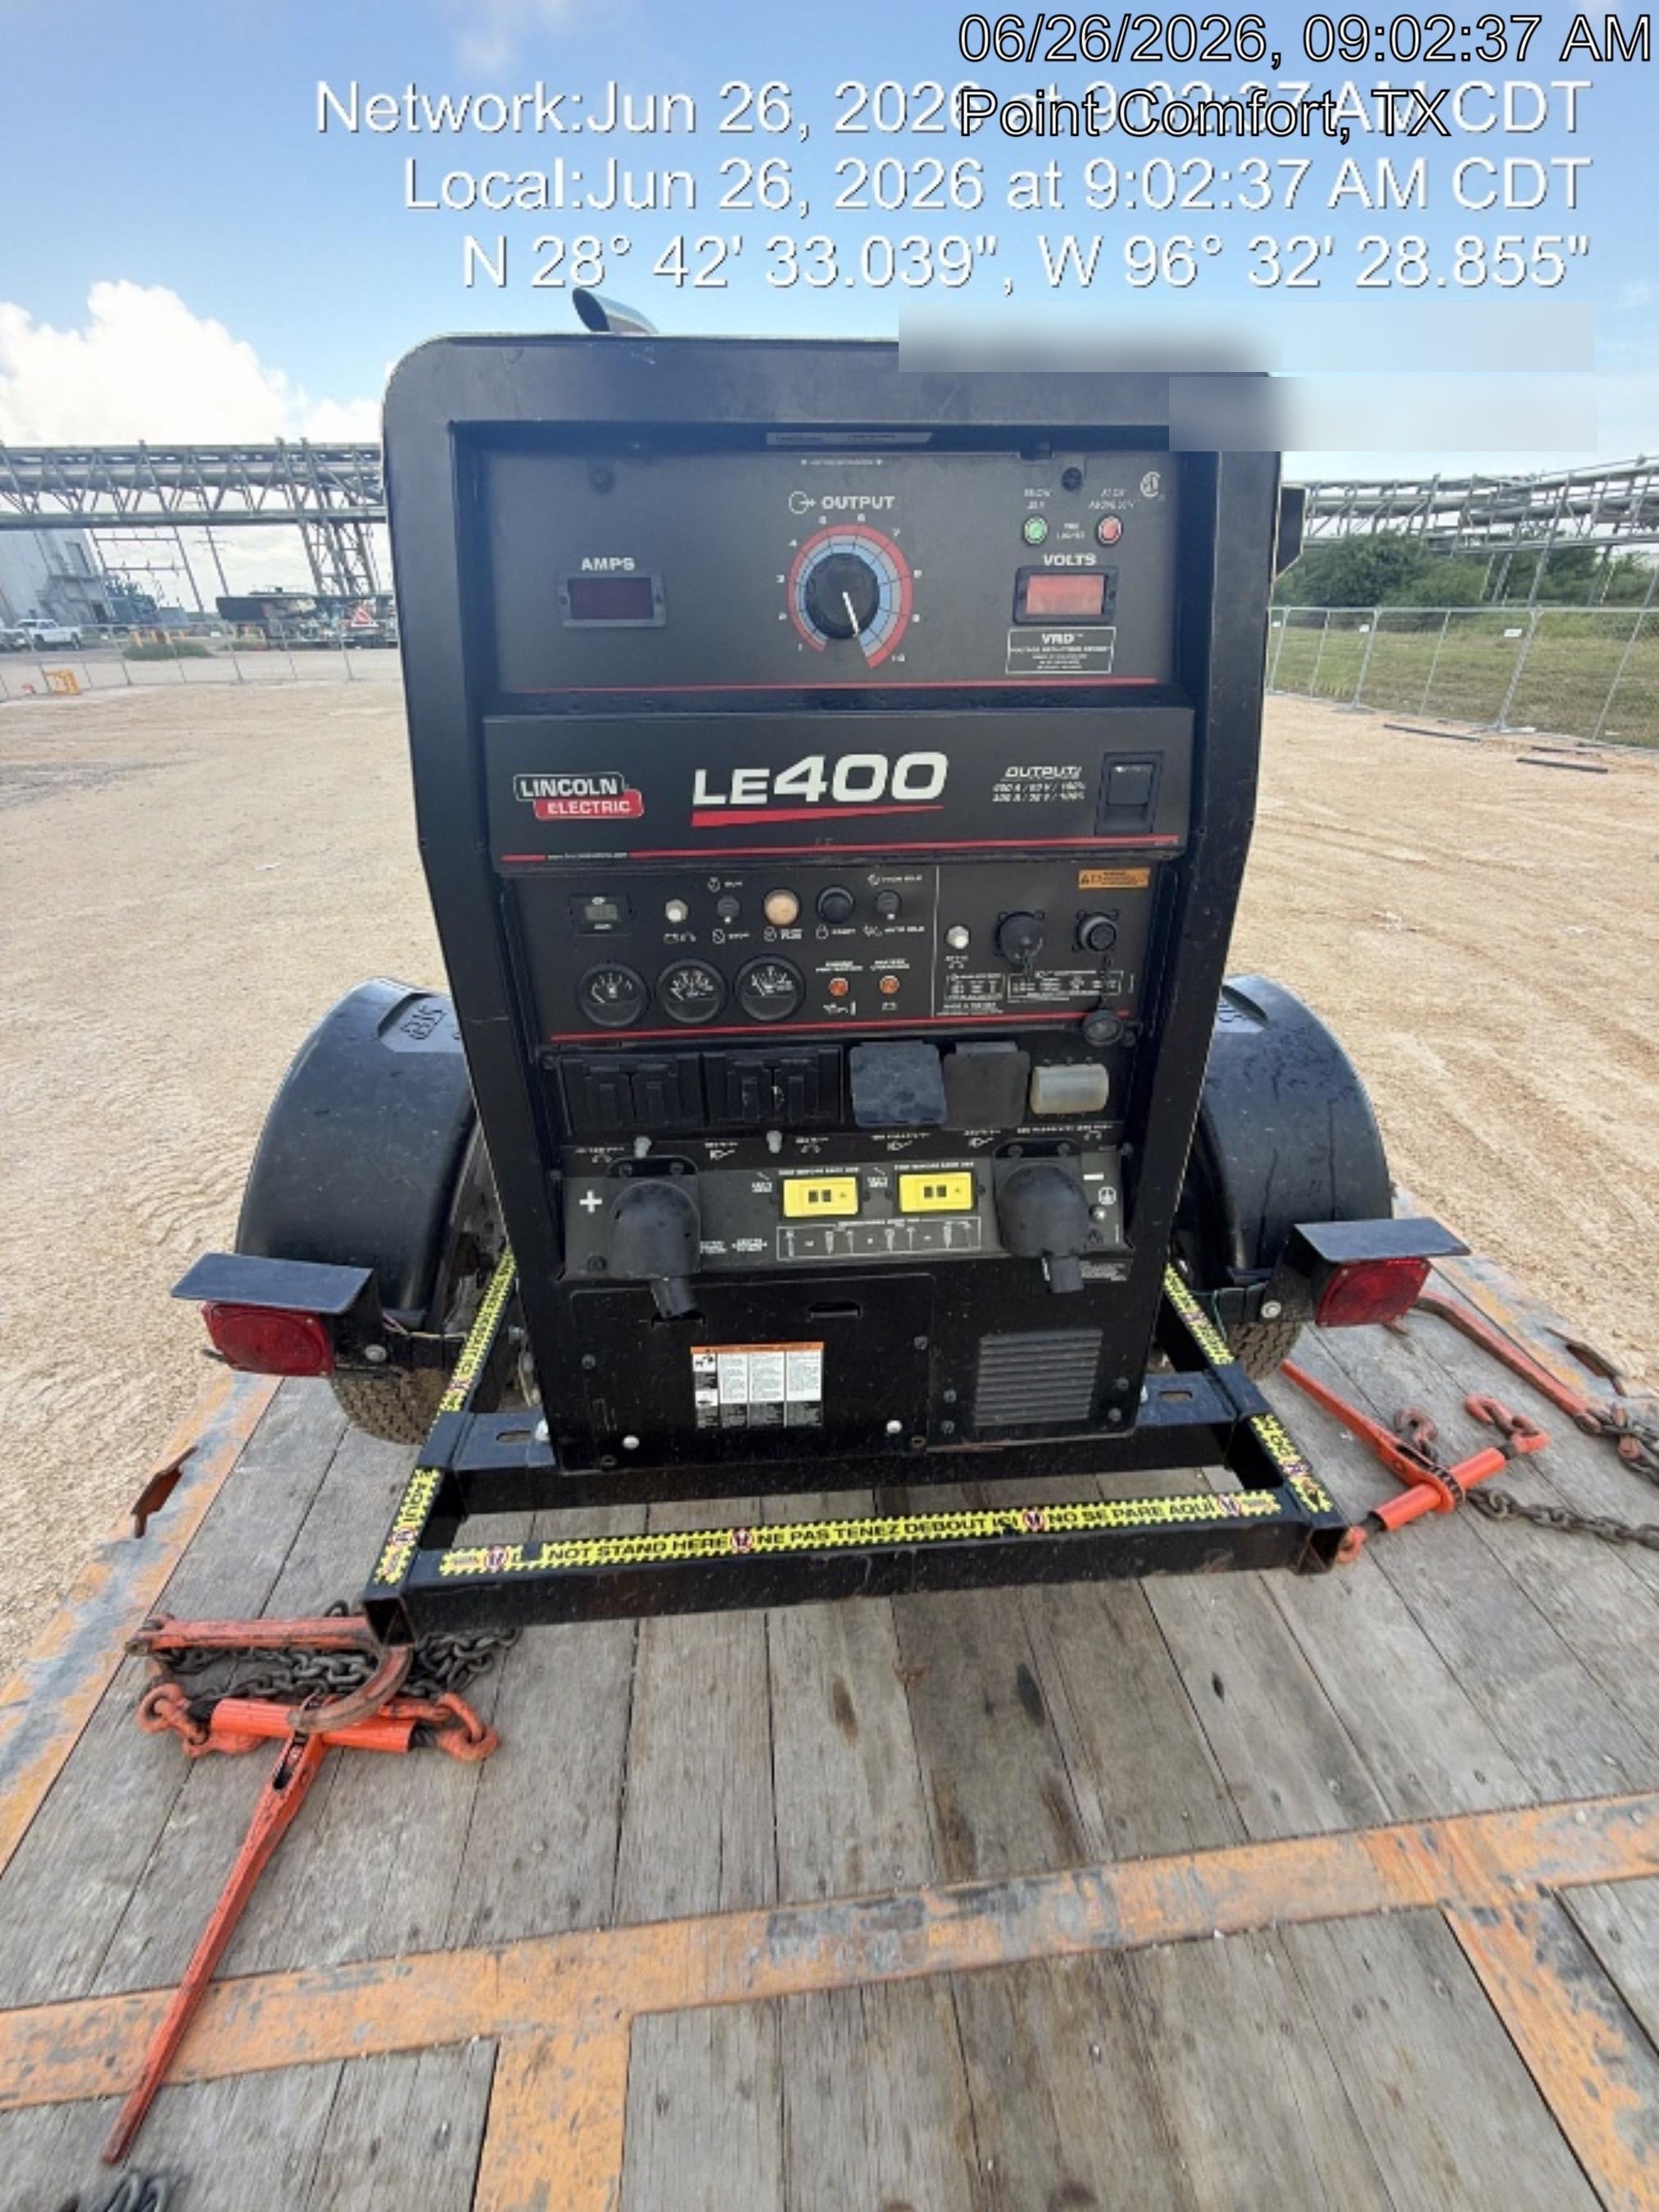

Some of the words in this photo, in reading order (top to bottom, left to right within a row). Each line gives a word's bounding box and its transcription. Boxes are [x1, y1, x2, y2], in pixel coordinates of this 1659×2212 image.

[821, 496, 895, 510] OUTPUT
[581, 557, 636, 571] AMPS
[1042, 553, 1097, 566] VOLTS
[520, 777, 619, 798] LINCOLN
[692, 751, 949, 805] LE400
[546, 799, 631, 816] ELECTRIC
[1048, 1511, 1078, 1524] NO
[1081, 1509, 1104, 1522] SE
[1110, 1505, 1164, 1520] PARE
[756, 1533, 786, 1545] NE
[790, 1529, 830, 1543] PAS
[832, 1524, 901, 1539] TENEZ
[903, 1517, 986, 1535] DEBOUT
[548, 1547, 591, 1561] NOT
[596, 1540, 667, 1557] STAND
[672, 1535, 728, 1552] HERE
